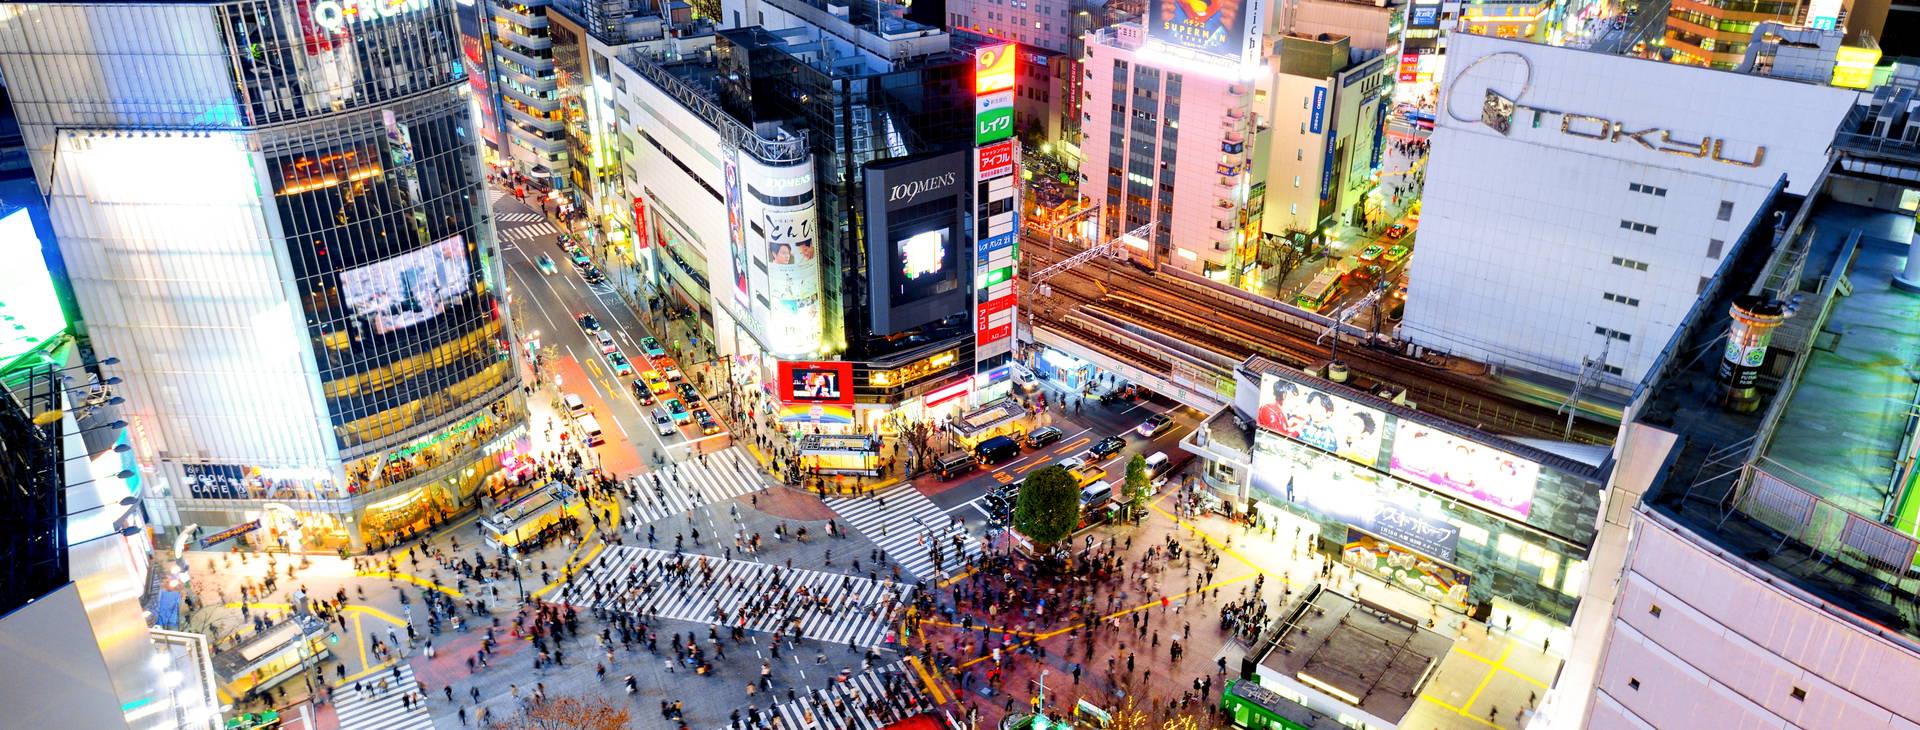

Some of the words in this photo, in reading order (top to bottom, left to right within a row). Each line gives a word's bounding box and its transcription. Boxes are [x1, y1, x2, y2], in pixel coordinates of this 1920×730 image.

[1163, 21, 1227, 43] SUPERMAN
[980, 115, 1010, 135] レイク
[1516, 103, 1766, 168] TOKYU
[981, 153, 1010, 169] アイフル
[888, 171, 956, 203] 109MEN'S
[979, 308, 987, 331] アコム
[389, 432, 450, 461] STARBUCKS
[483, 424, 528, 457] TSUTAYA
[192, 484, 229, 494] CAFE
